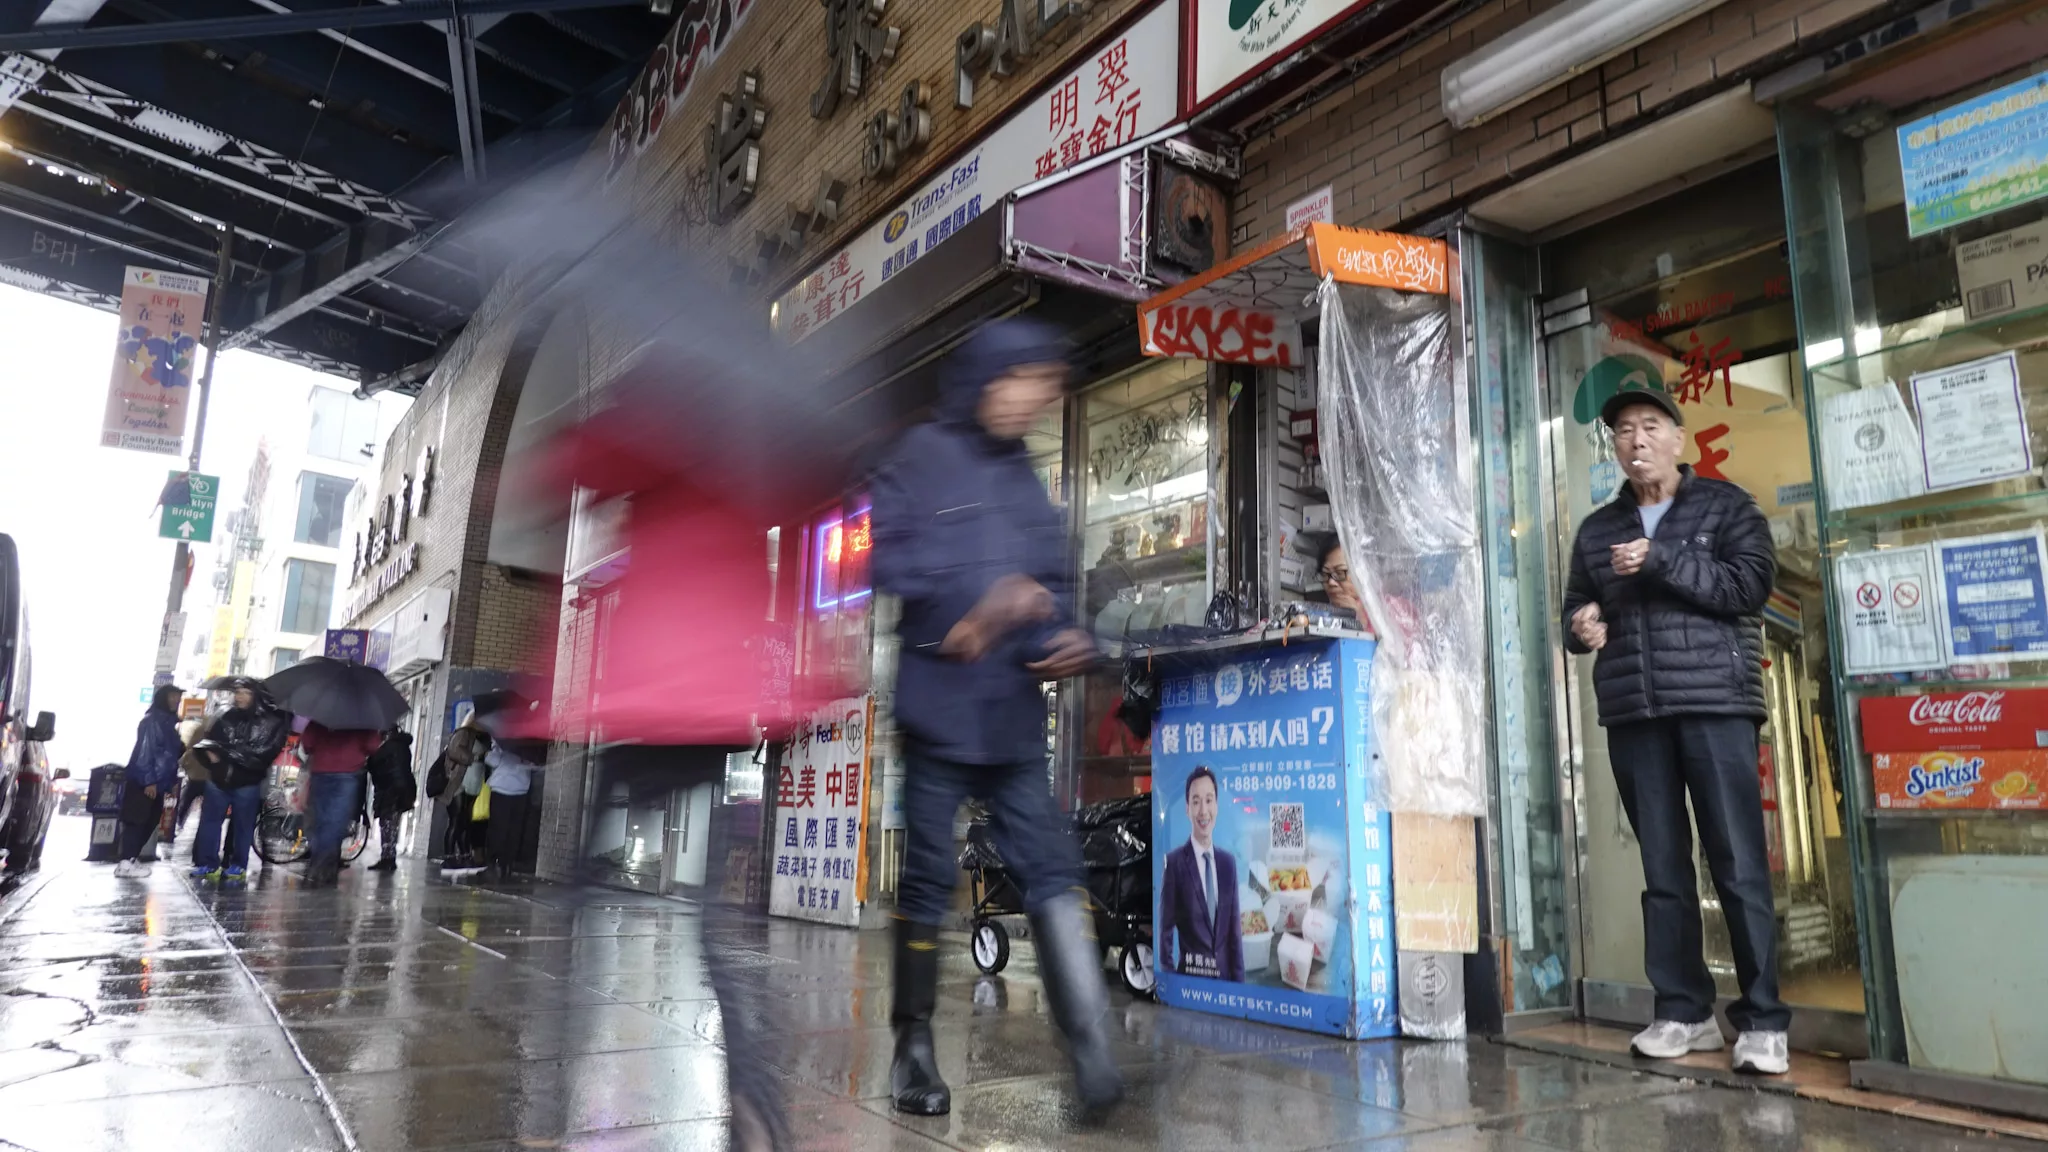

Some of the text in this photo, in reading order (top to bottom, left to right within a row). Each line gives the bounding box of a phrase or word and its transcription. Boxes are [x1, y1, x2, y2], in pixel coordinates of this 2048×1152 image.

[911, 154, 980, 220] Trans-Fast
[1290, 196, 1329, 222] SPRINKLER
[1646, 305, 1681, 333] SWAN
[1684, 291, 1735, 322] BAKERY
[121, 441, 174, 454] Foundation
[122, 433, 181, 447] Cathay Bank
[1845, 451, 1901, 469] NO ENTRY
[172, 507, 206, 519] Bridge
[1248, 660, 1333, 697] 外卖电话
[1909, 691, 2005, 726] Coca-Cola
[816, 722, 843, 744] FedEx
[1161, 721, 1205, 755] 餐馆
[1965, 724, 1987, 732] TASTE
[777, 762, 861, 809] 全美 中國
[1222, 774, 1337, 792] 1-888-909-1828
[1906, 757, 1984, 798] Sunkist
[1945, 786, 1975, 798] Orange
[776, 855, 817, 879] 蔬菜種子
[797, 884, 840, 910] 電話充值
[1181, 987, 1313, 1019] WWW.GETSKT.COM
